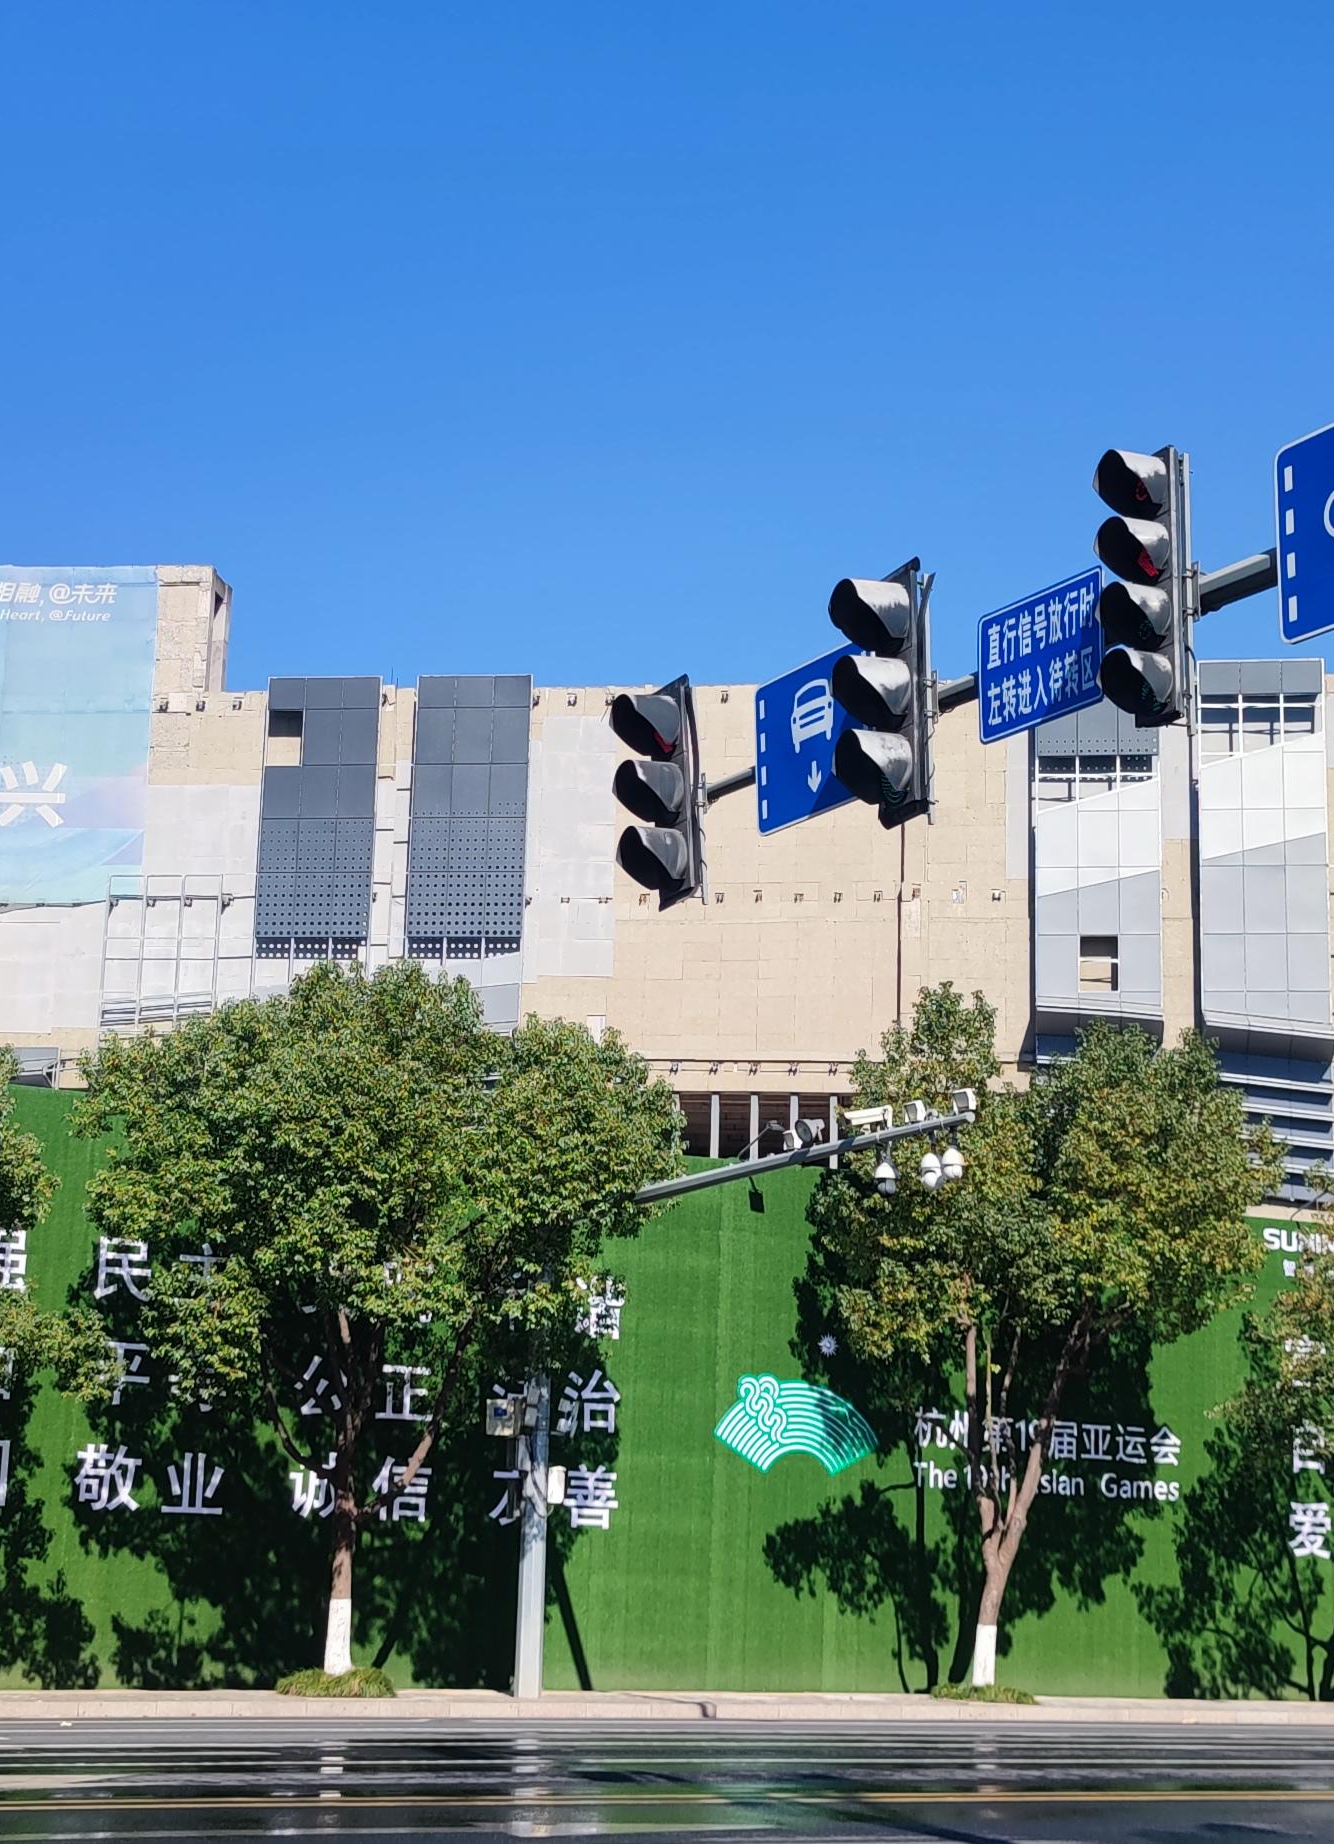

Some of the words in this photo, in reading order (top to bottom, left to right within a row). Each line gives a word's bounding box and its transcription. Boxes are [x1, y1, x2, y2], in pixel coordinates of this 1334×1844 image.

[0, 608, 45, 624] Heart,
[49, 609, 111, 623] @Future
[987, 582, 1095, 671] 直行信号放行时
[987, 646, 1095, 726] 左转进入待转区
[74, 1443, 225, 1516] 敬业
[914, 1460, 958, 1490] The
[1100, 1471, 1181, 1502] Games
